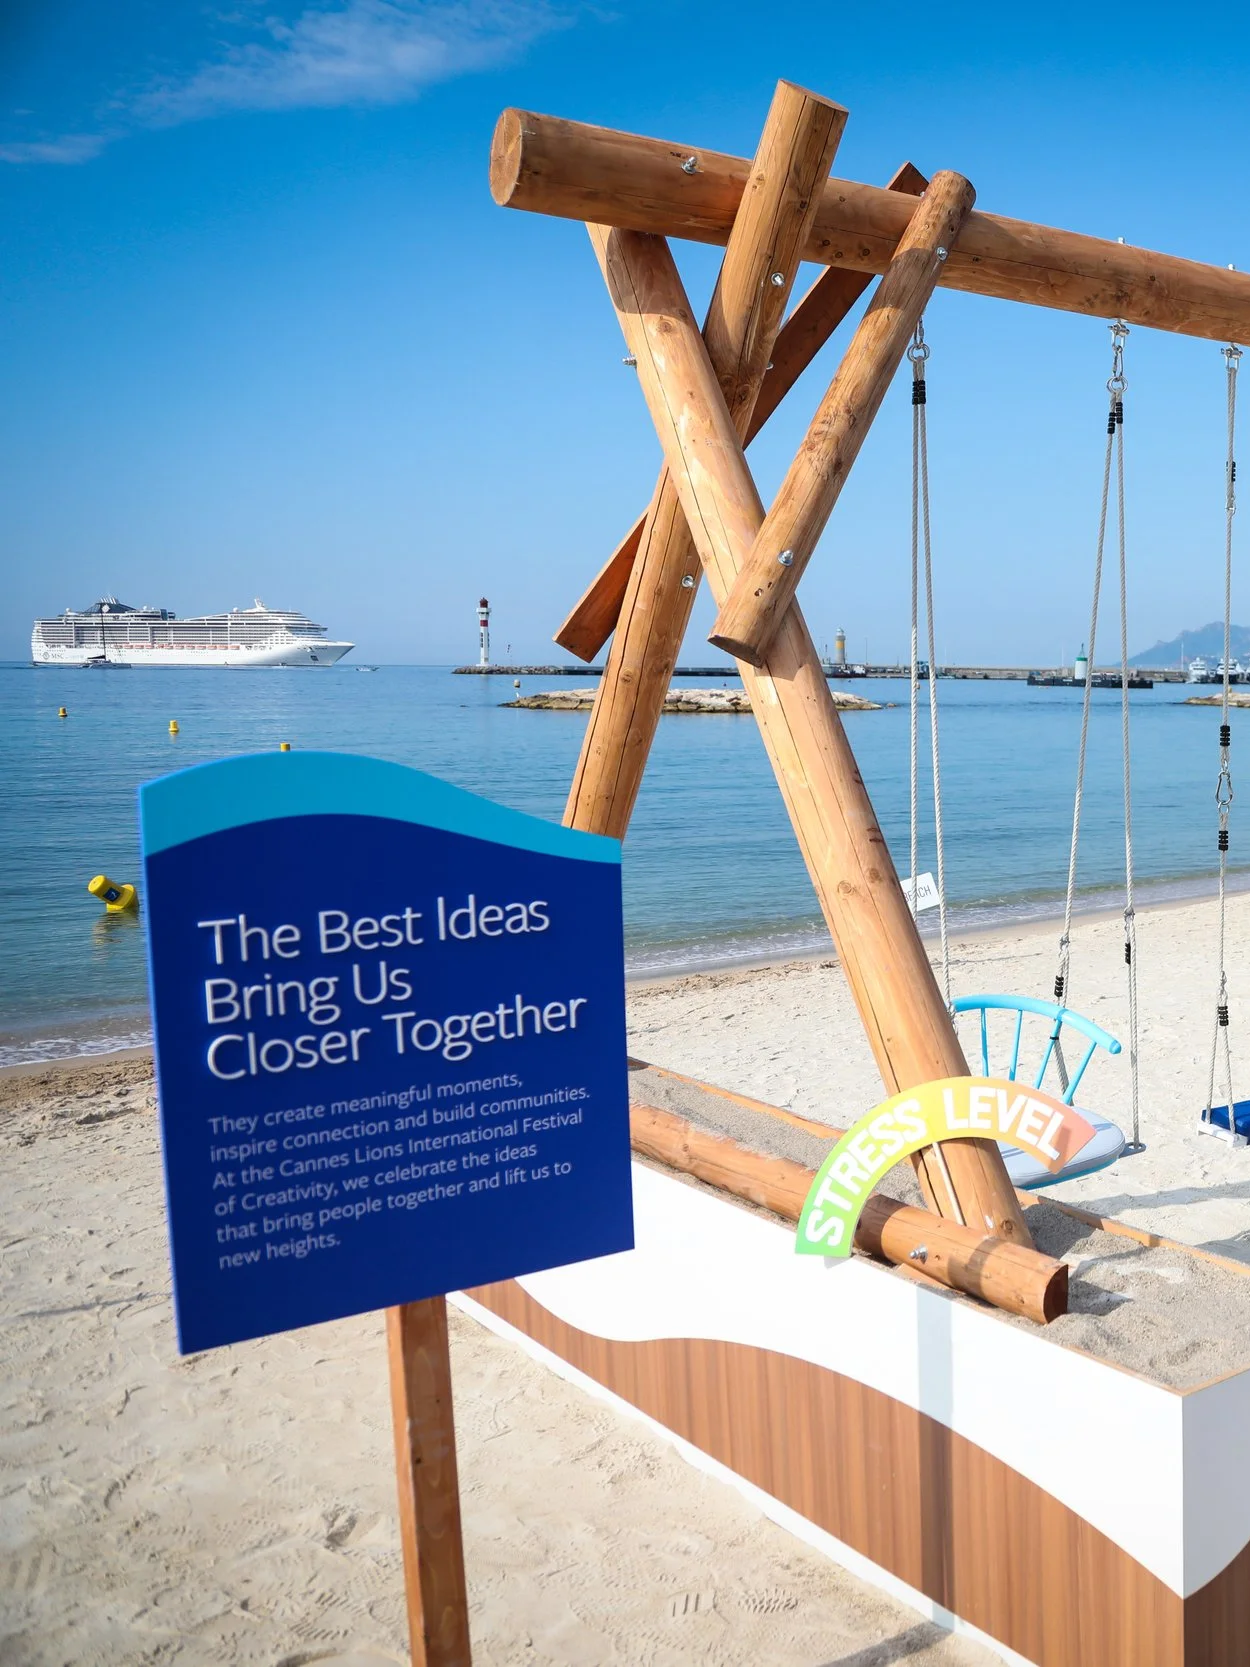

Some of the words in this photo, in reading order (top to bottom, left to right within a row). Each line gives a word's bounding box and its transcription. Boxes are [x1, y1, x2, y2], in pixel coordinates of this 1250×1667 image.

[198, 914, 300, 964] The
[319, 908, 423, 953] Best
[438, 894, 549, 940] Ideas
[205, 974, 340, 1025] Bring
[353, 961, 412, 1004] Us
[207, 1028, 370, 1080] Closer
[382, 994, 587, 1061] Together
[209, 1115, 259, 1135] They
[264, 1105, 325, 1126] create
[331, 1083, 432, 1113] meaningful
[437, 1074, 523, 1098] moments,
[211, 1139, 278, 1162] inspire
[283, 1120, 390, 1150] connection
[395, 1110, 428, 1131] and
[433, 1103, 474, 1124] build
[480, 1087, 591, 1117] communities.
[213, 1172, 236, 1189] At
[241, 1165, 274, 1184] the
[280, 1154, 349, 1176] Cannes
[355, 1144, 403, 1163] Lions
[408, 1119, 519, 1153] International
[523, 1108, 582, 1132] Festival
[214, 1195, 237, 1216] of
[242, 1183, 340, 1211] Creativity,
[342, 1175, 369, 1191] we
[374, 1158, 458, 1185] celebrate
[461, 1151, 492, 1169] the
[495, 1145, 537, 1162] ideas
[805, 1098, 928, 1247] STRESS
[943, 1086, 1065, 1161] LEVEL
[217, 1221, 259, 1242] that
[263, 1212, 315, 1232] bring
[319, 1197, 383, 1222] people
[387, 1182, 465, 1210] together
[469, 1172, 499, 1192] and
[504, 1165, 527, 1185] lift
[531, 1165, 551, 1180] us
[554, 1161, 572, 1176] to
[219, 1249, 261, 1269] new
[266, 1234, 341, 1258] heights.
